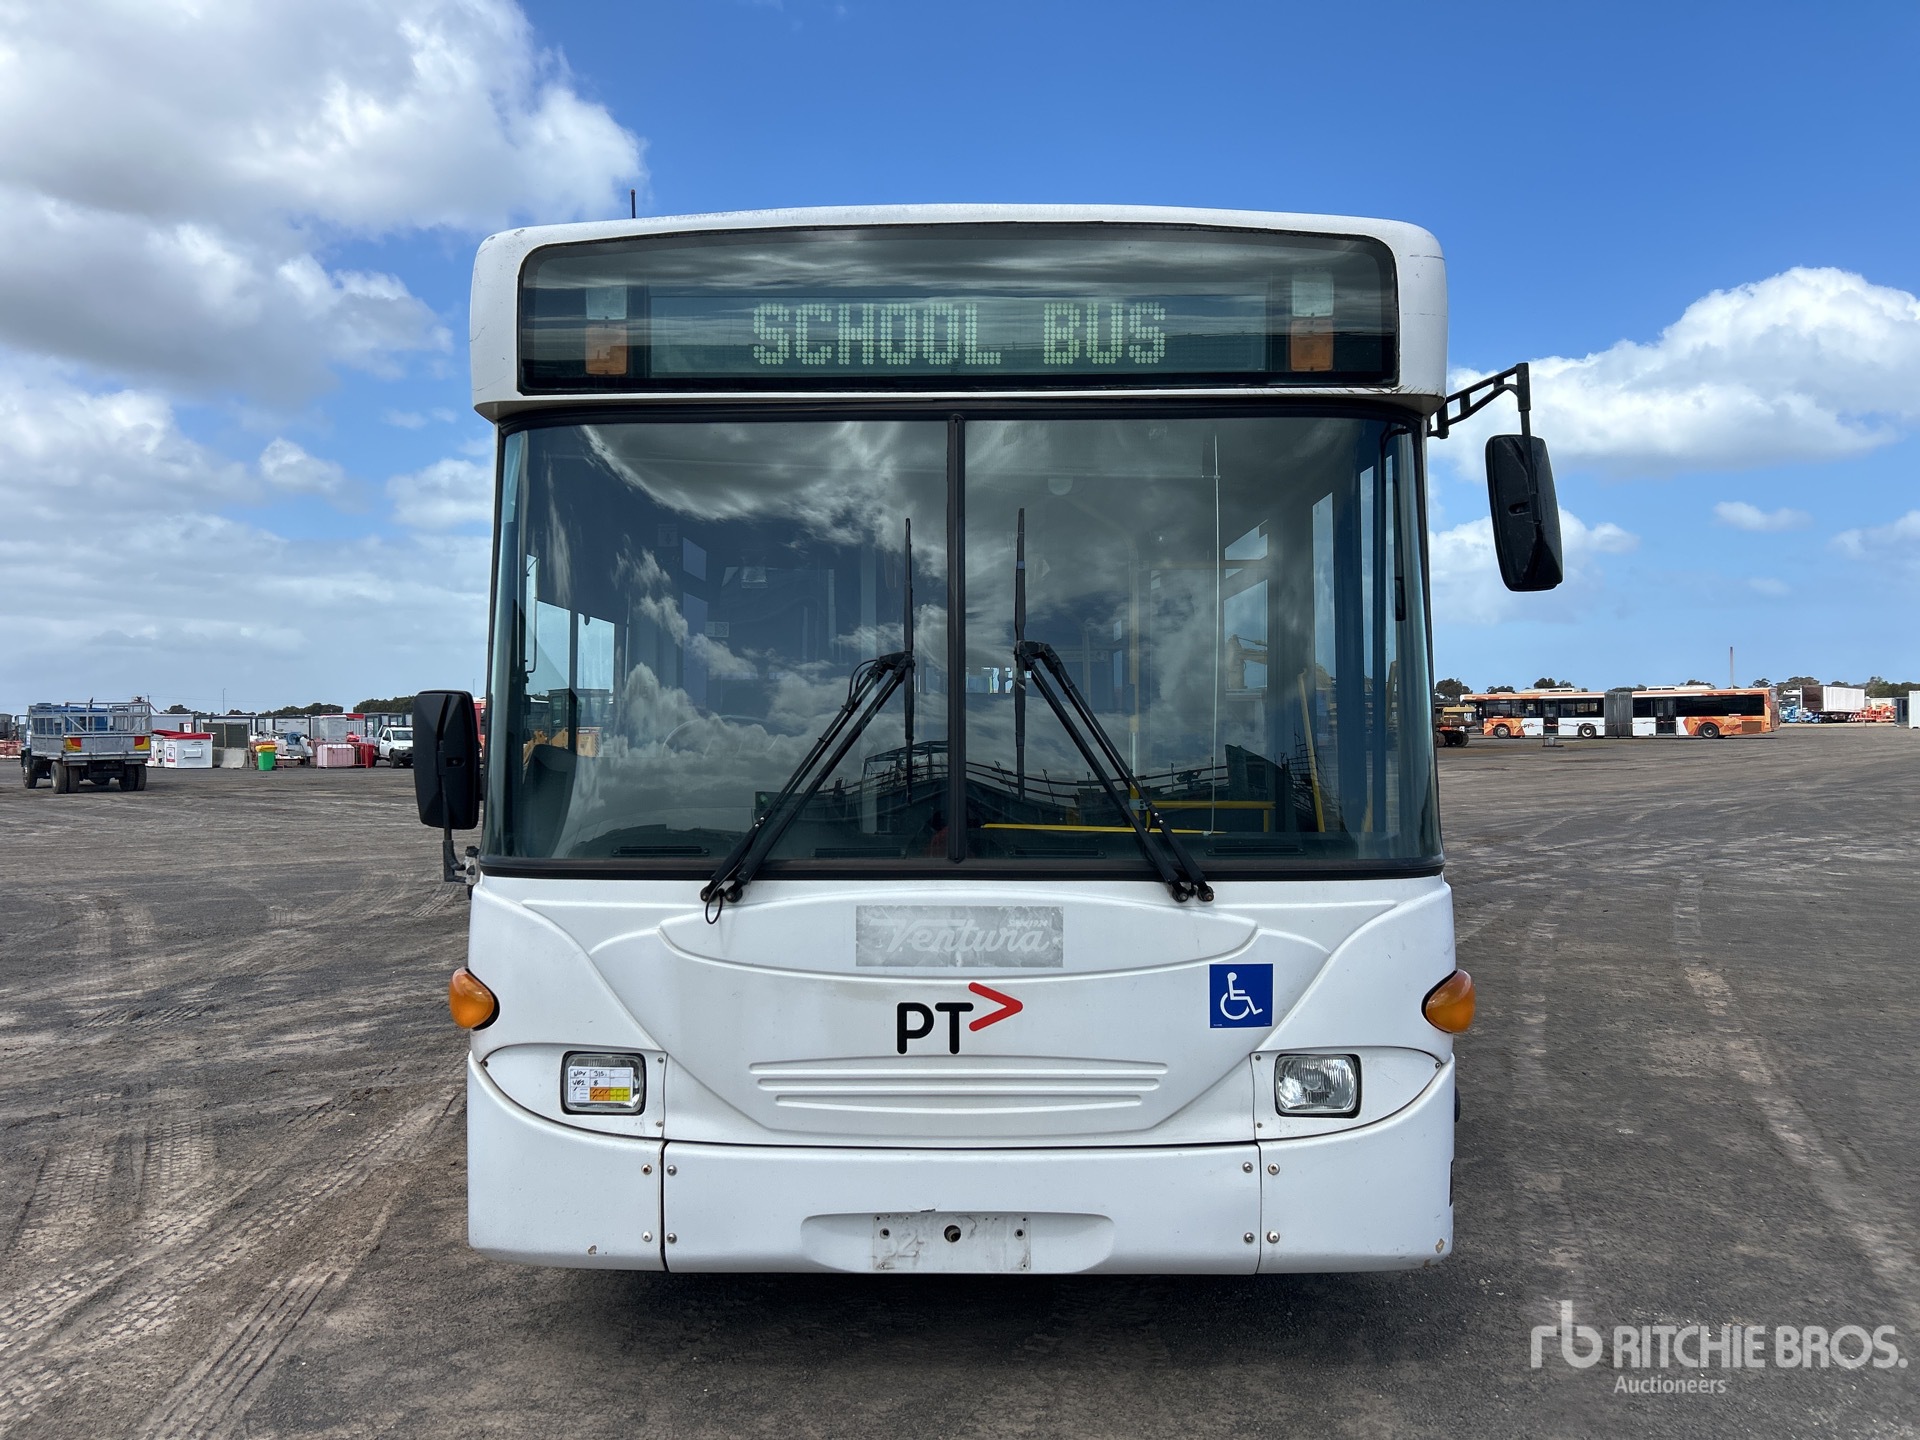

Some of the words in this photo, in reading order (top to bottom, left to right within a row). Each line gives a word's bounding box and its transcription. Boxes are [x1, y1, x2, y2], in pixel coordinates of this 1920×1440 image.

[753, 302, 1001, 365] SCHOOL
[1043, 301, 1166, 364] BUS
[868, 918, 1049, 953] Ventura
[897, 1002, 974, 1055] PT
